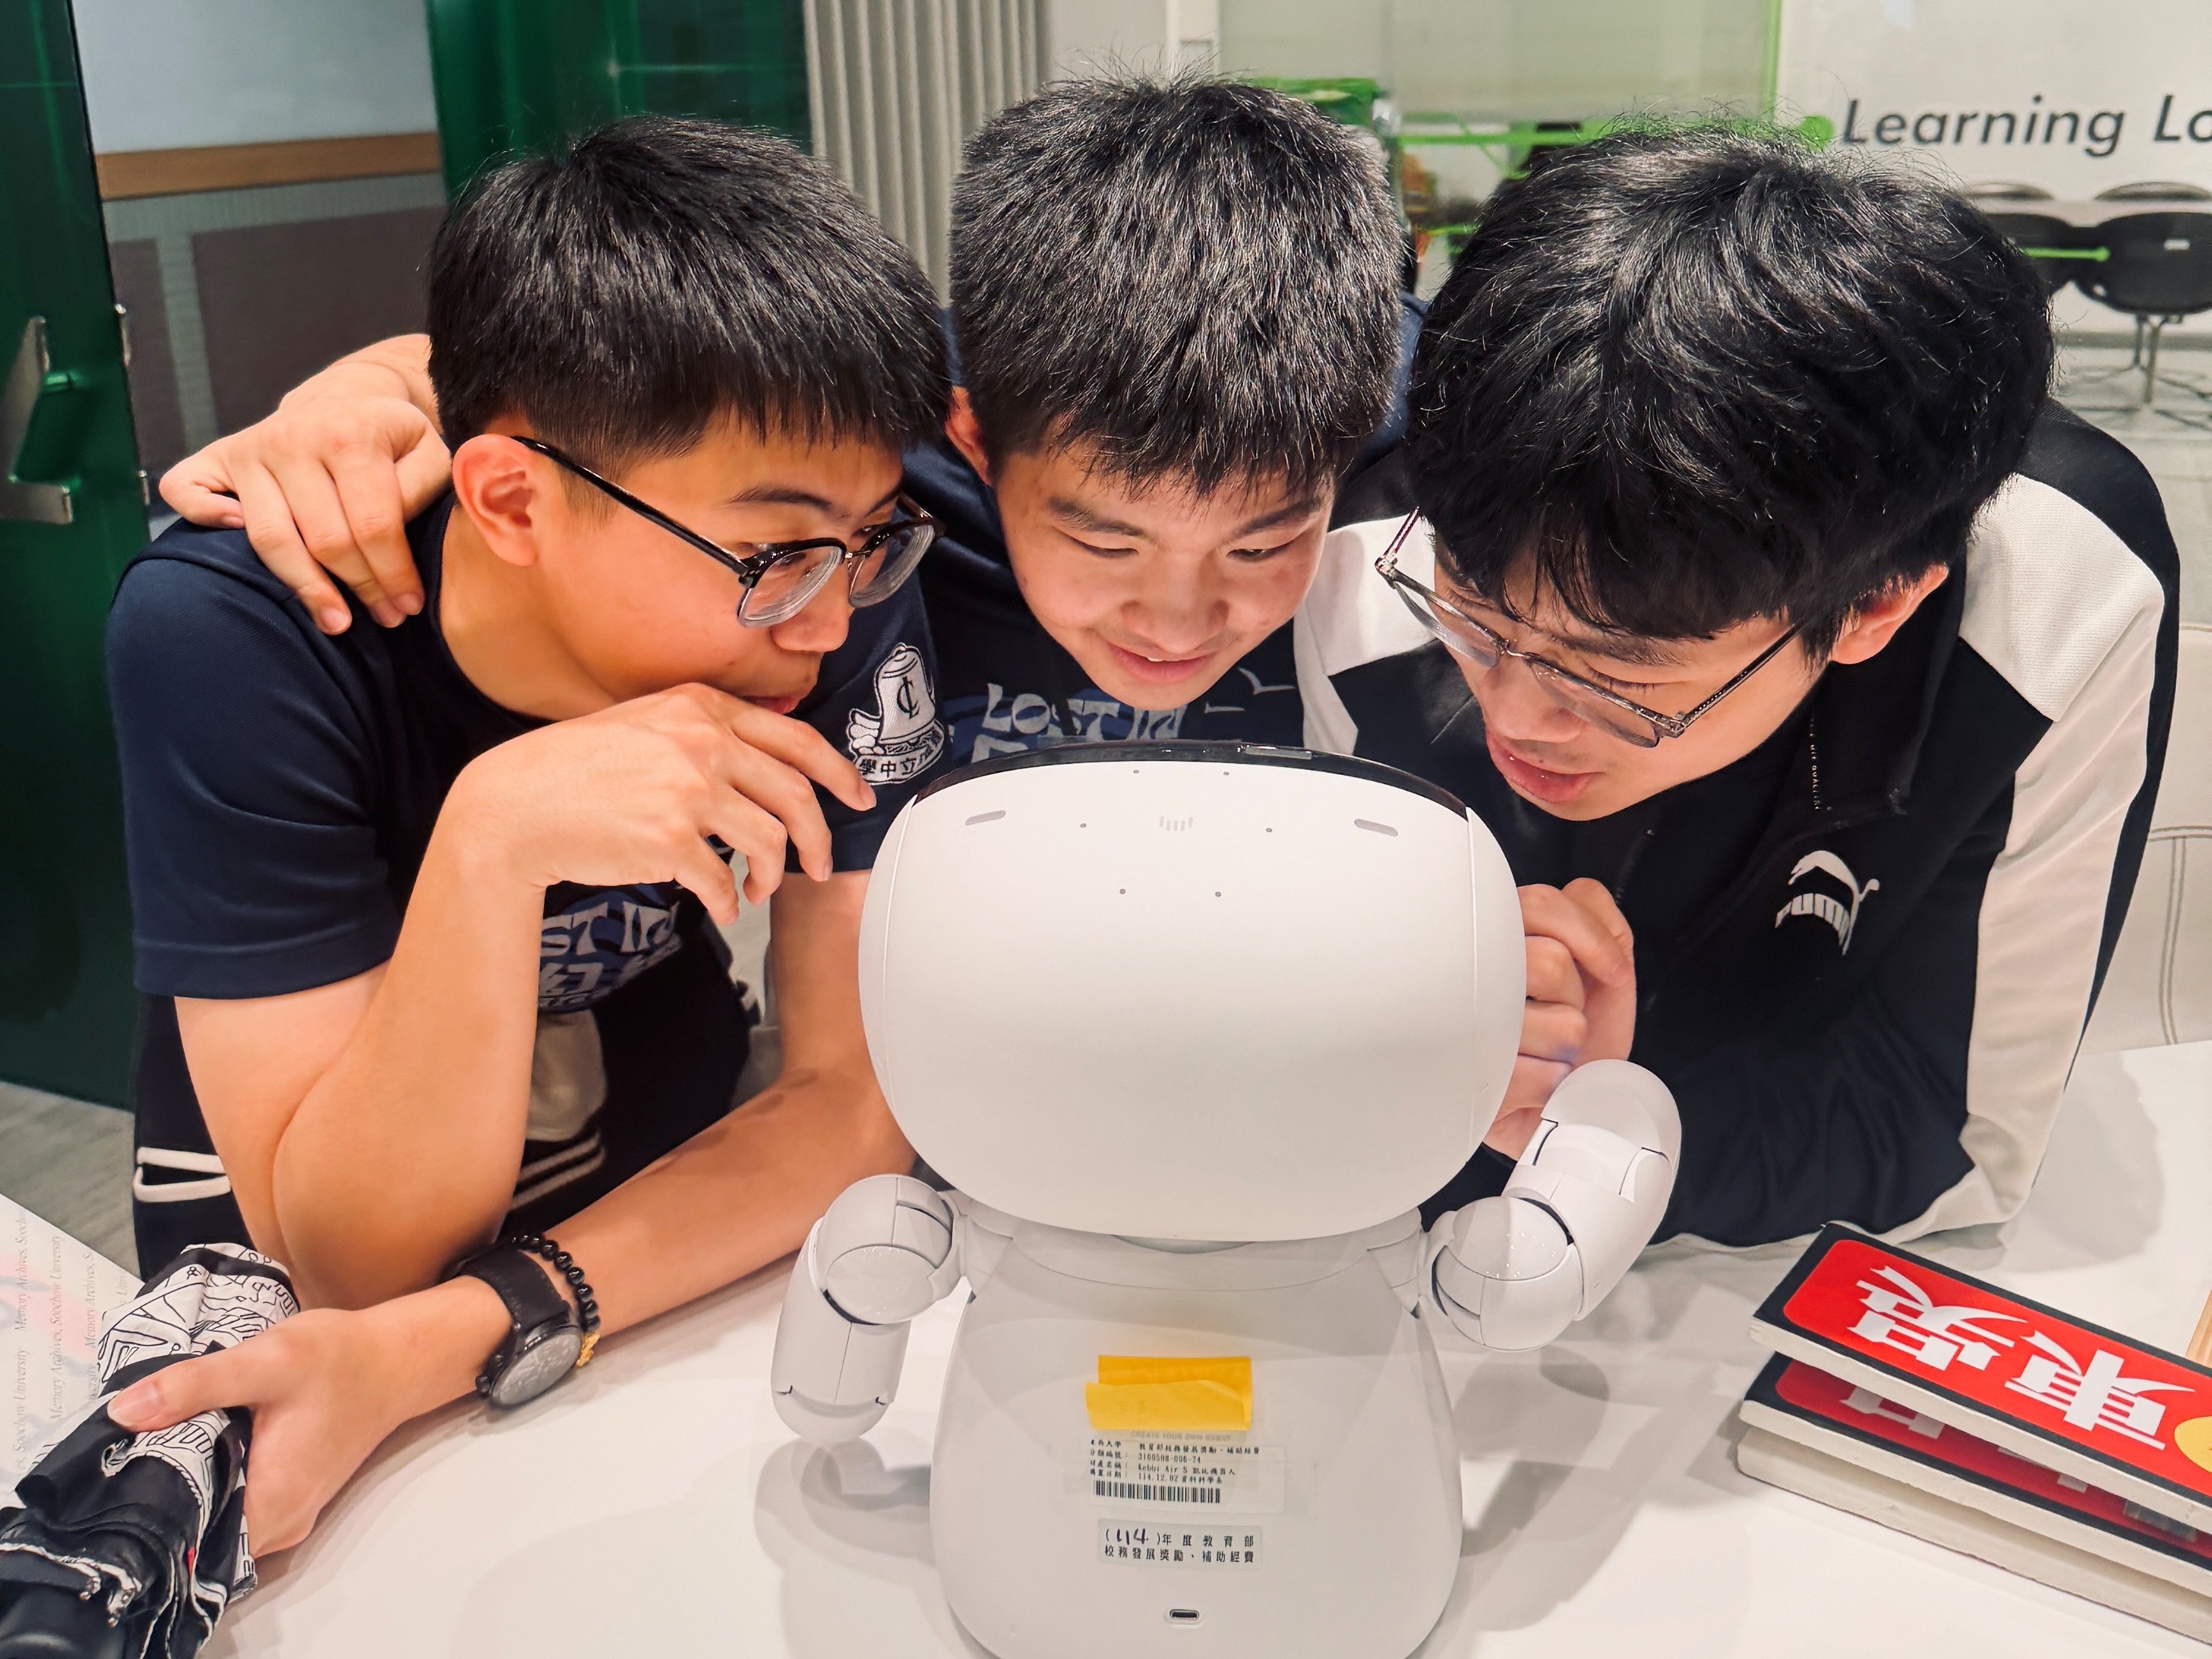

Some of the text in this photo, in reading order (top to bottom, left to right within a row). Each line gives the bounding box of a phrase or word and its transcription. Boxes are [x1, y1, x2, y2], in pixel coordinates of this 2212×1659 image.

[1843, 92, 2212, 160] Learning Lo
[49, 1236, 65, 1280] University
[14, 1290, 30, 1332] Memory
[49, 1285, 62, 1326] Soochow
[83, 1309, 98, 1348] Memory
[14, 1347, 29, 1401] University
[1847, 1265, 2195, 1451] 東吳
[50, 1378, 65, 1419] Memory
[1130, 1431, 1161, 1439] CREATE
